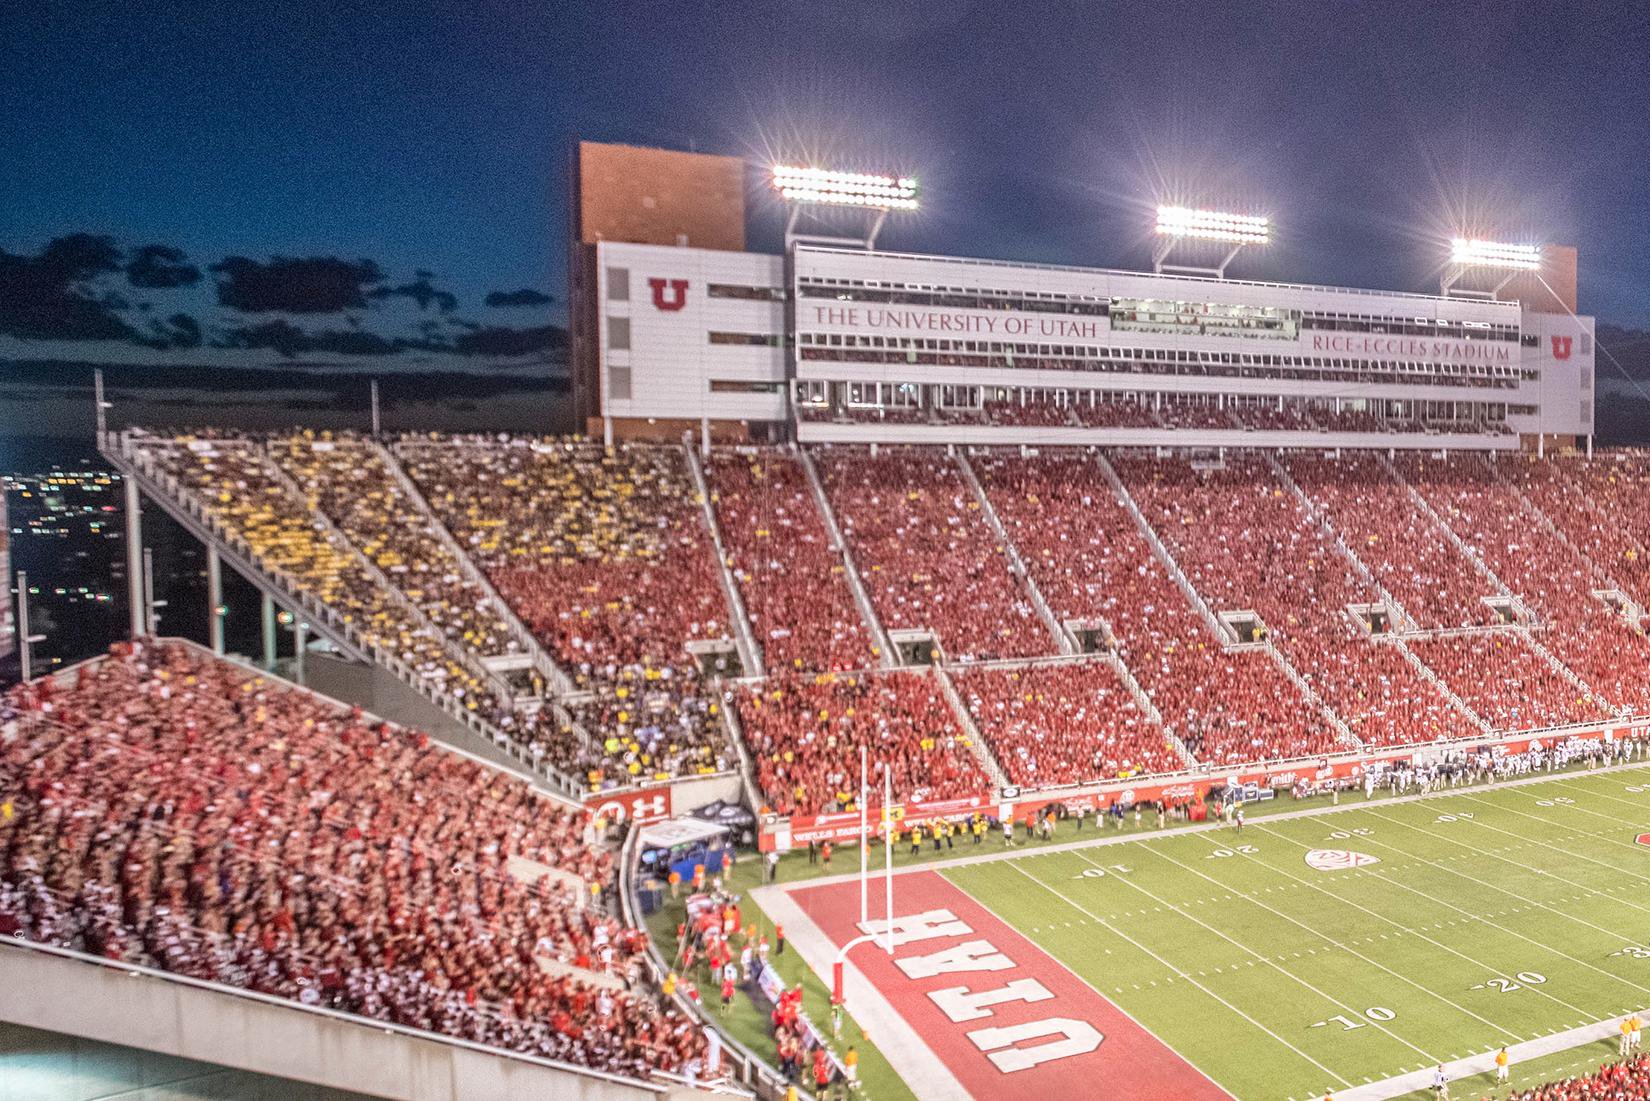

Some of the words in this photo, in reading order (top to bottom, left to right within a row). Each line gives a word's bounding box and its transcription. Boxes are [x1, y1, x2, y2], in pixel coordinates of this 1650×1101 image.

[648, 277, 689, 312] U
[816, 306, 858, 326] THE
[867, 309, 998, 332] UNIVERSITY
[1004, 316, 1033, 335] OF
[1040, 319, 1096, 338] UTAH
[1313, 335, 1428, 356] RICE-ECCLES
[1433, 342, 1509, 361] STADIUM
[1551, 336, 1573, 361] U
[1212, 844, 1260, 858] 20
[1082, 863, 1133, 878] 10
[855, 908, 1105, 1074] UTAH
[1486, 970, 1549, 993] 20
[1327, 1006, 1398, 1032] 10
